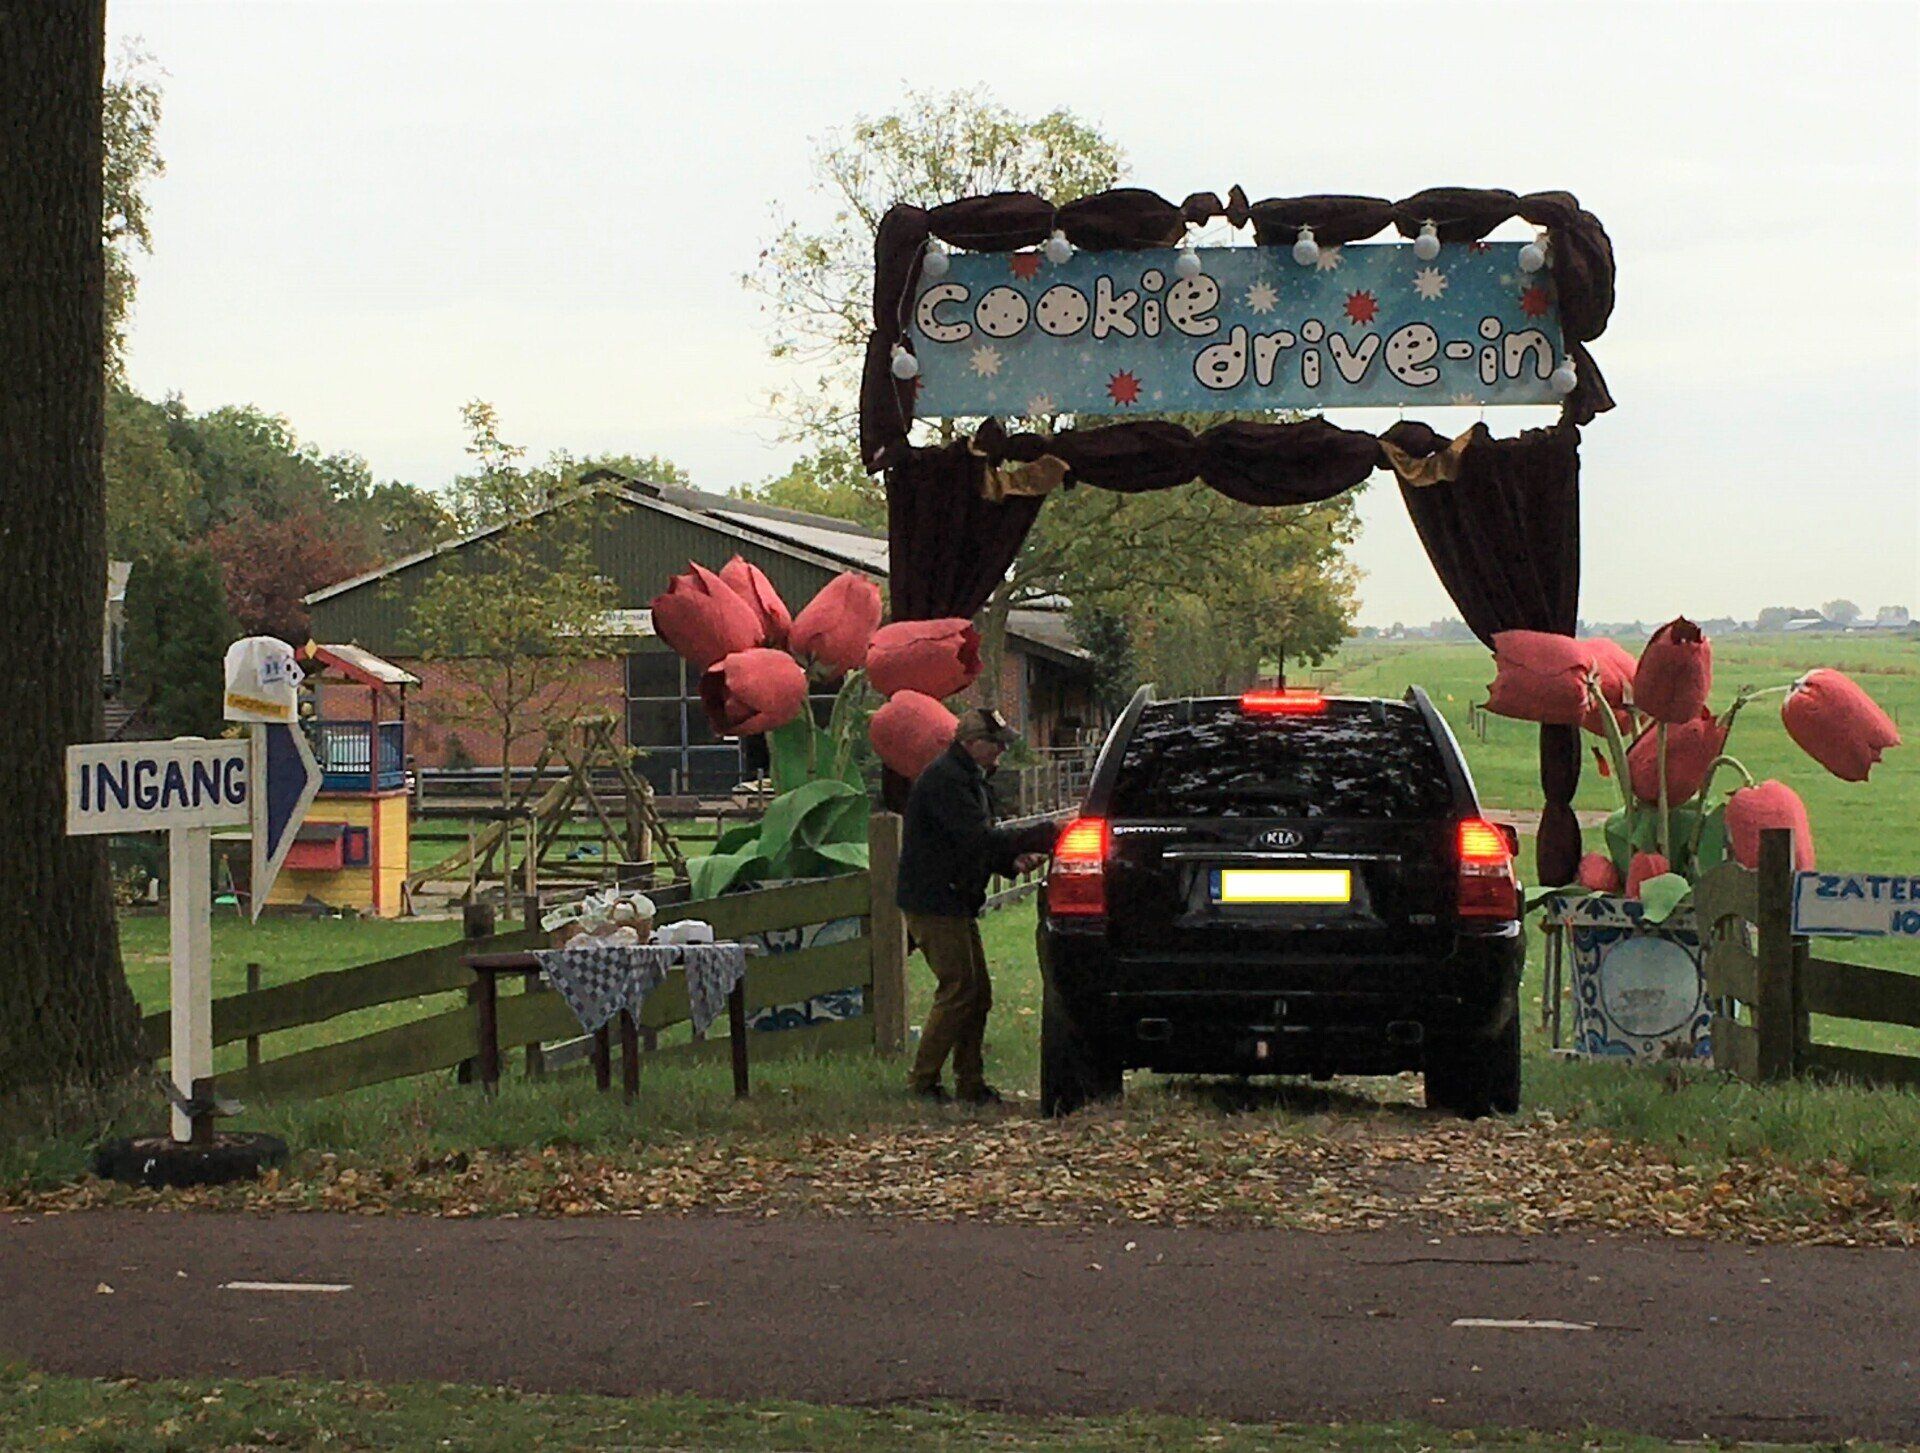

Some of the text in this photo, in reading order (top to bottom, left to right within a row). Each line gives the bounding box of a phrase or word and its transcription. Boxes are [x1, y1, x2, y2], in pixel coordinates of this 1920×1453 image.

[915, 269, 1221, 343] cookie
[1193, 316, 1556, 390] drive-in
[80, 757, 247, 812] INGANG
[1267, 831, 1295, 844] KIA
